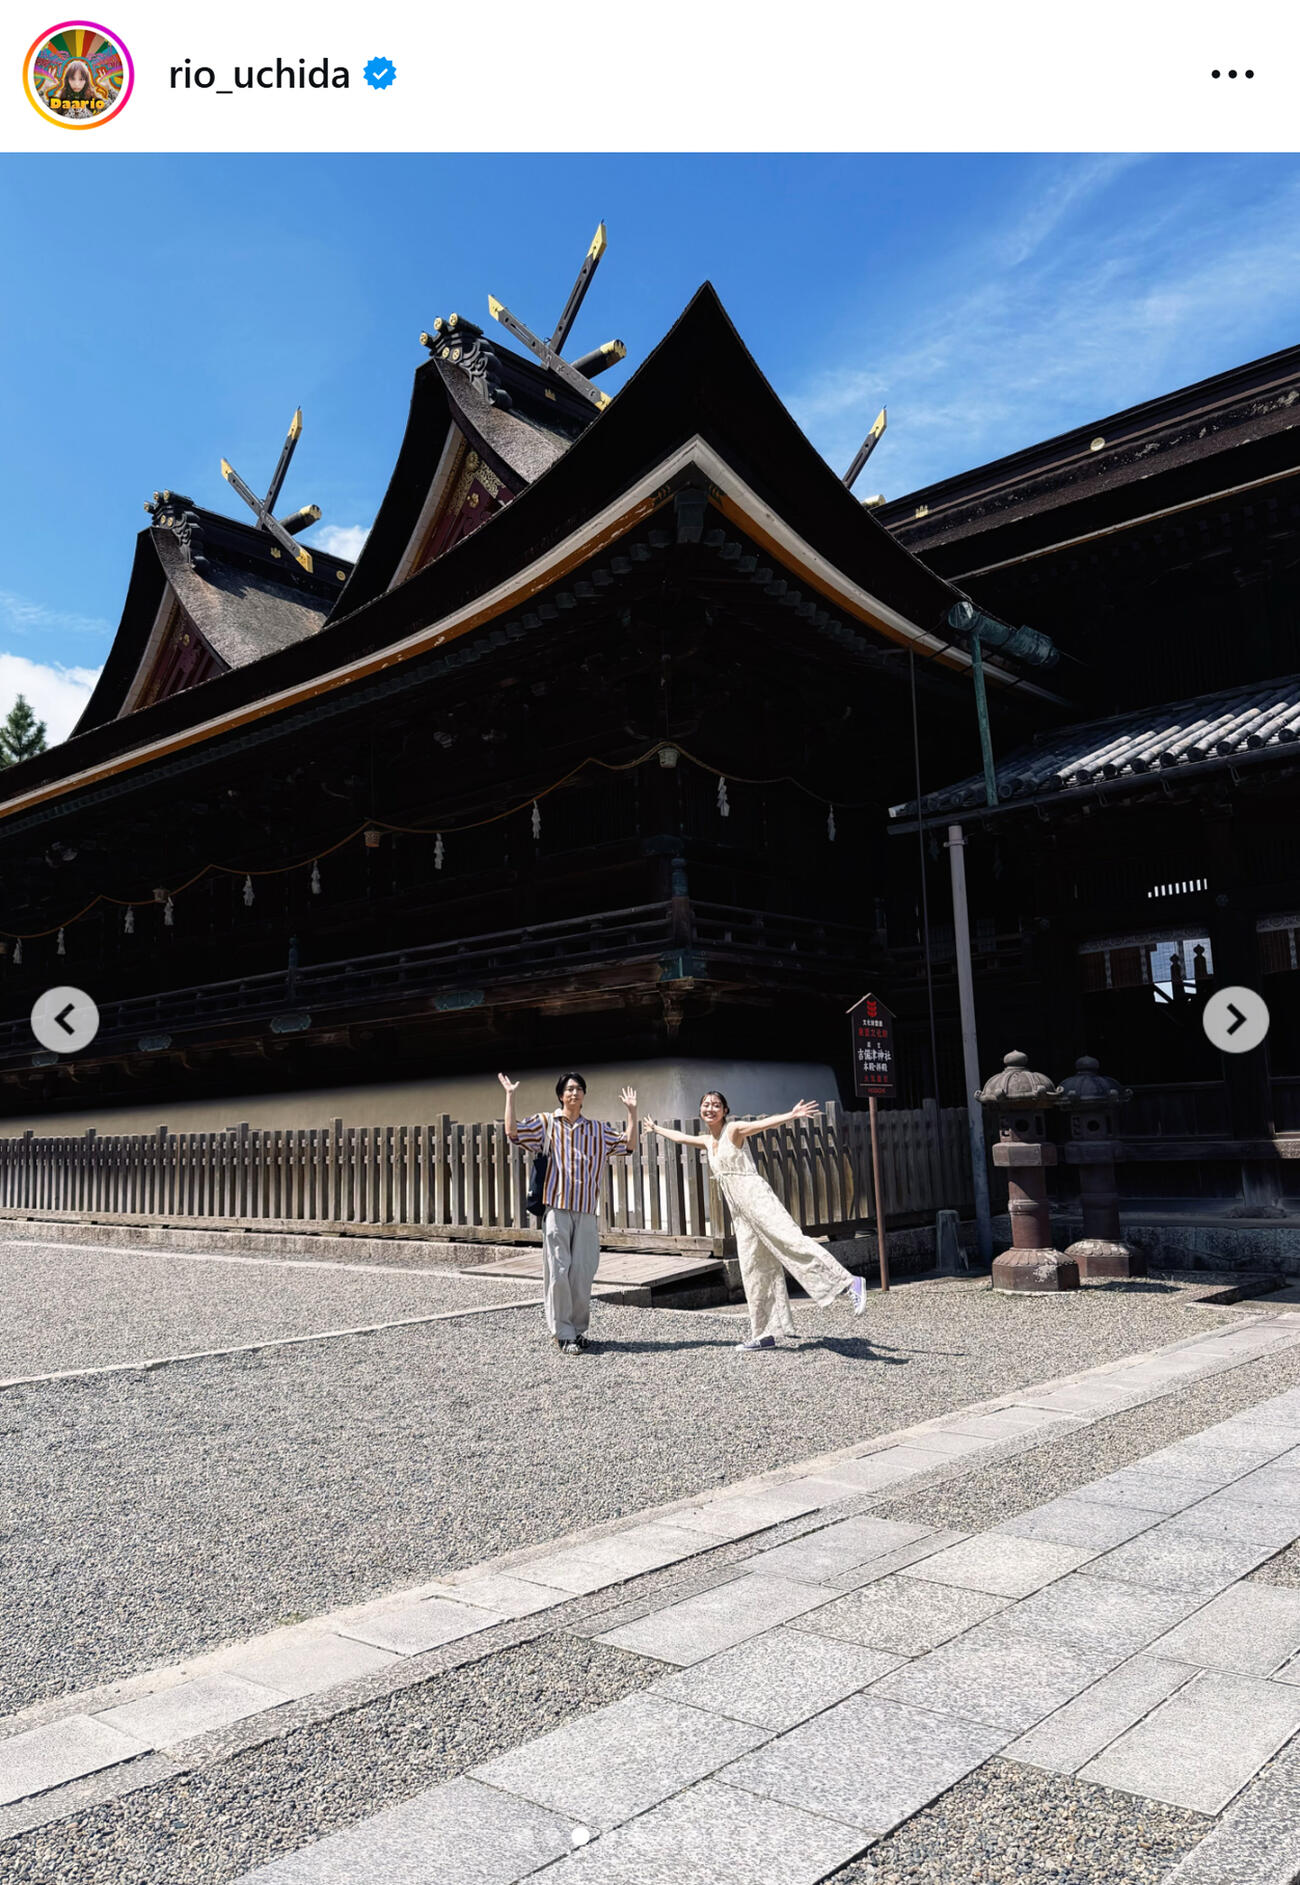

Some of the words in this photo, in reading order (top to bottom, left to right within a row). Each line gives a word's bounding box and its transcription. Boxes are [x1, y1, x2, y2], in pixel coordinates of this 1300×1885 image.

[857, 1048, 892, 1061] 吉備津神社
